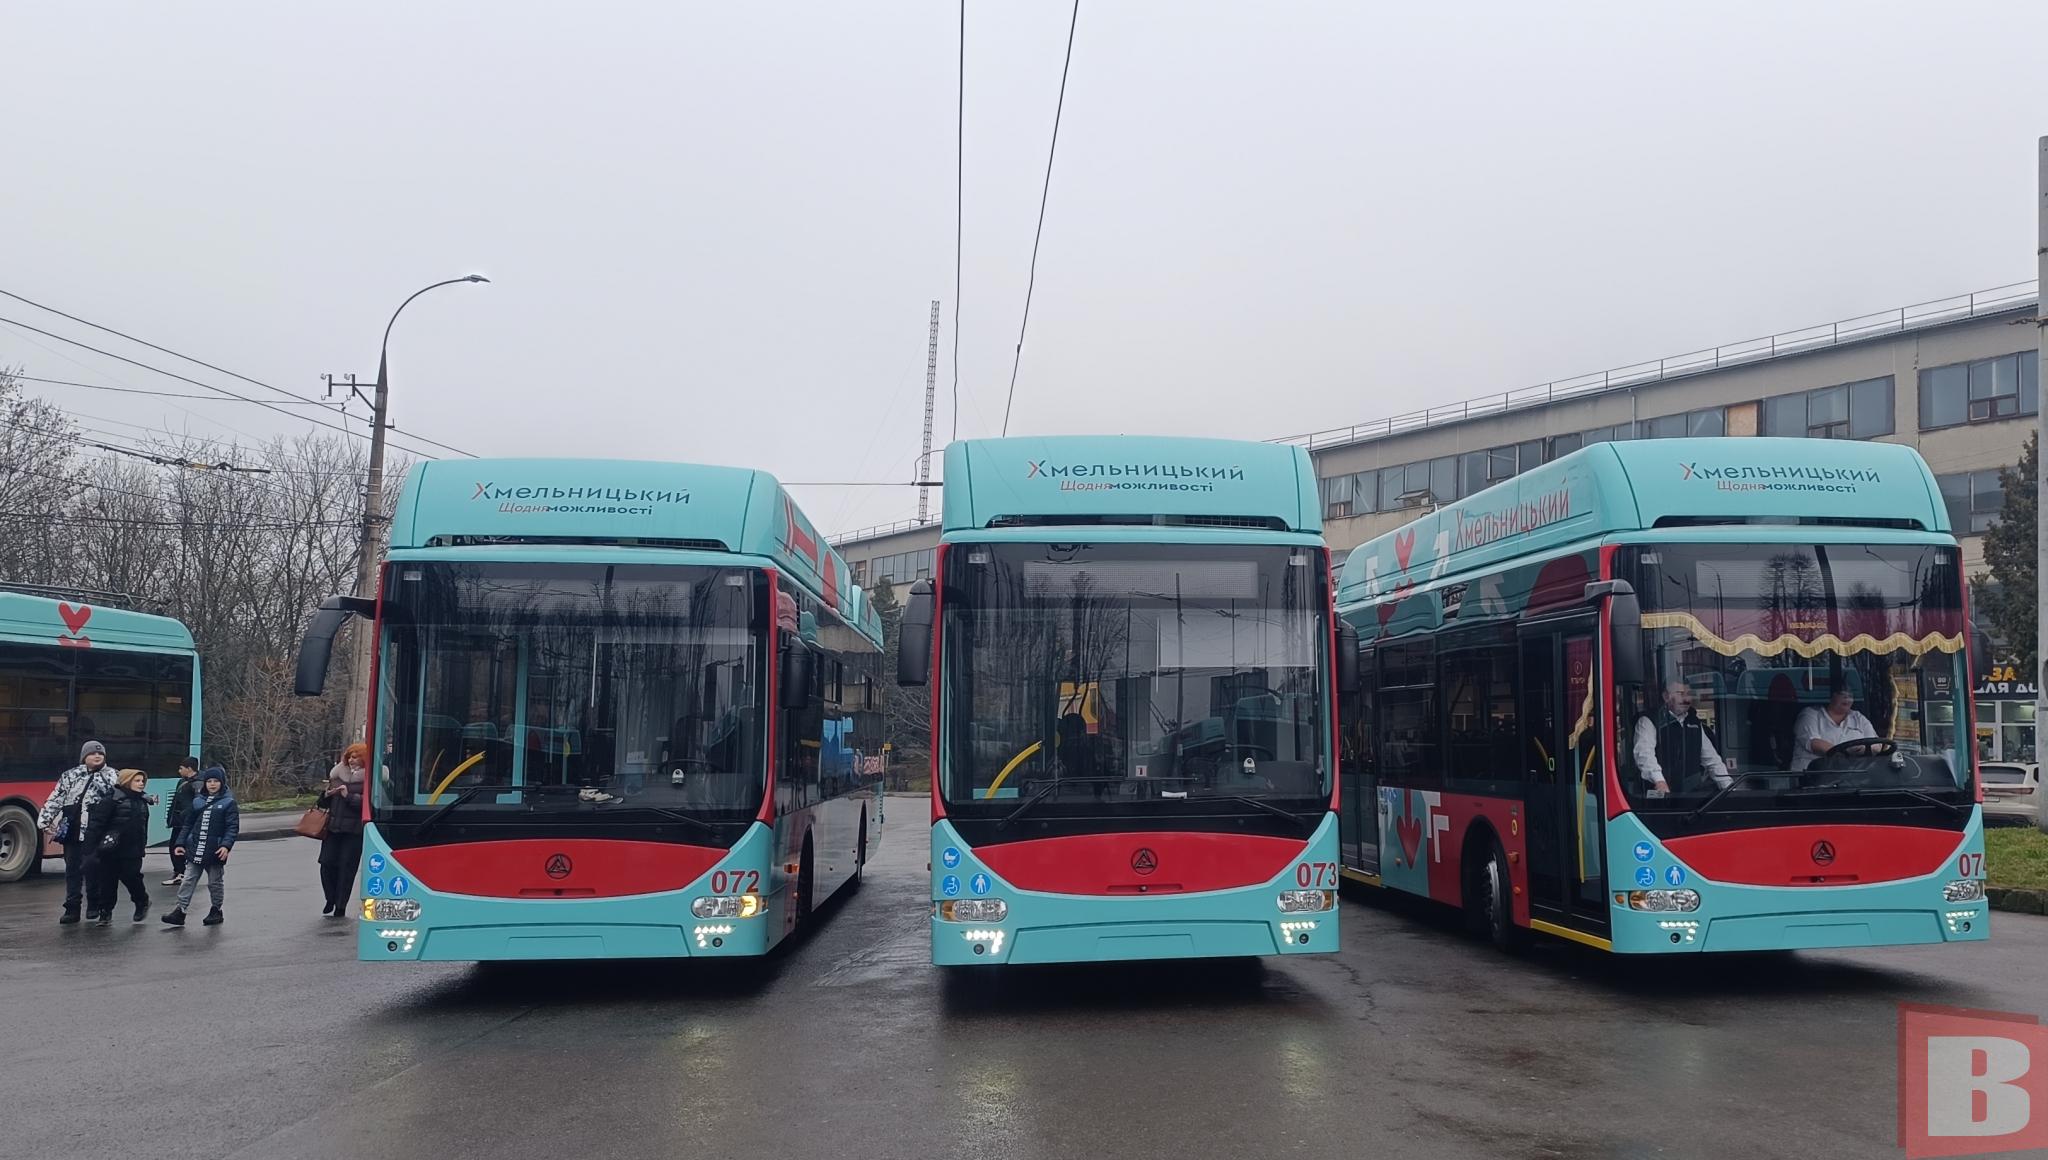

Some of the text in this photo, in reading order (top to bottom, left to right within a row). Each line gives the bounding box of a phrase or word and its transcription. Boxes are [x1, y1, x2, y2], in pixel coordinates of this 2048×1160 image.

[1027, 460, 1244, 480] Хмельницький
[1680, 463, 1880, 483] Хмельницький
[472, 482, 690, 504] Хмельницький
[1456, 477, 1569, 551] Хмельницький
[1296, 862, 1337, 888] 073
[1958, 853, 1987, 878] 07
[711, 870, 760, 895] 072
